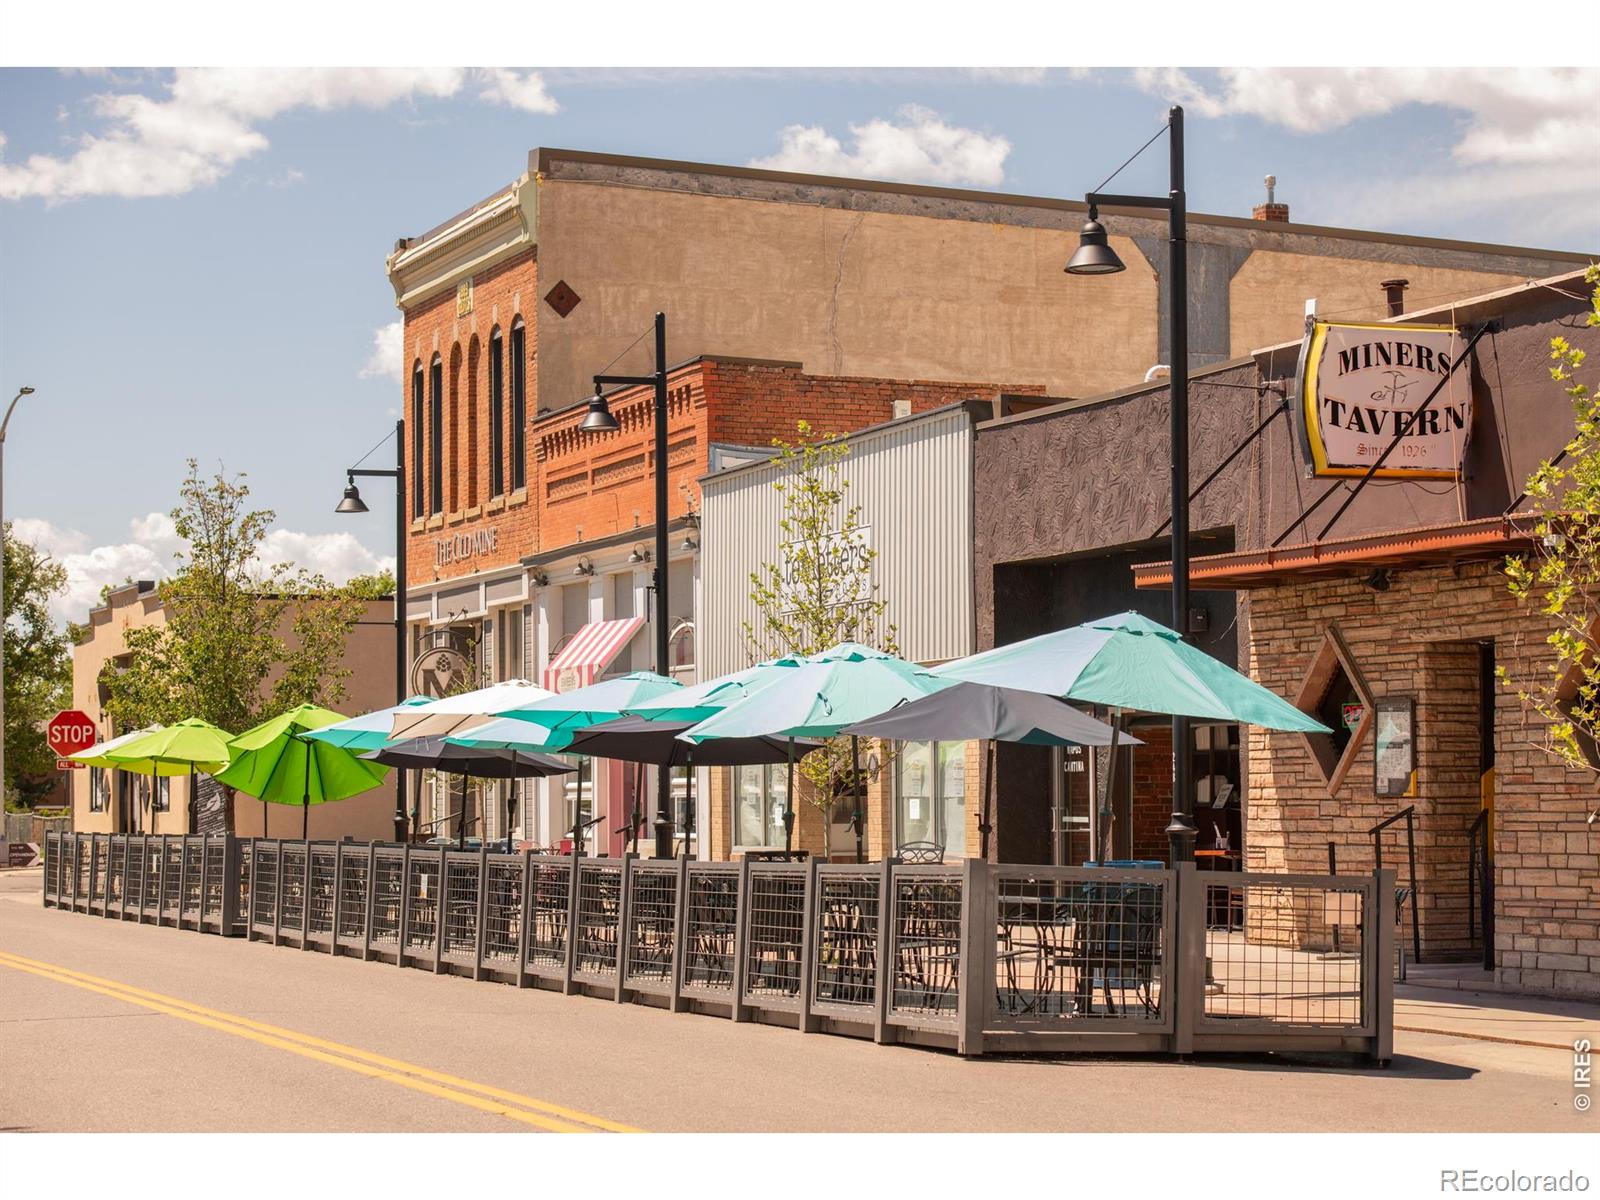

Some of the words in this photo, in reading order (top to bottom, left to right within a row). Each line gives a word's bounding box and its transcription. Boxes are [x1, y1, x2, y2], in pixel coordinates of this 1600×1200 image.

[1338, 342, 1453, 376] MINERS
[1324, 398, 1466, 437] TAVERN
[1357, 443, 1389, 457] Sinc
[1402, 444, 1427, 457] 1926
[435, 539, 452, 566] THE
[453, 533, 473, 563] OLD
[471, 526, 498, 557] MINE
[51, 725, 93, 743] STOP
